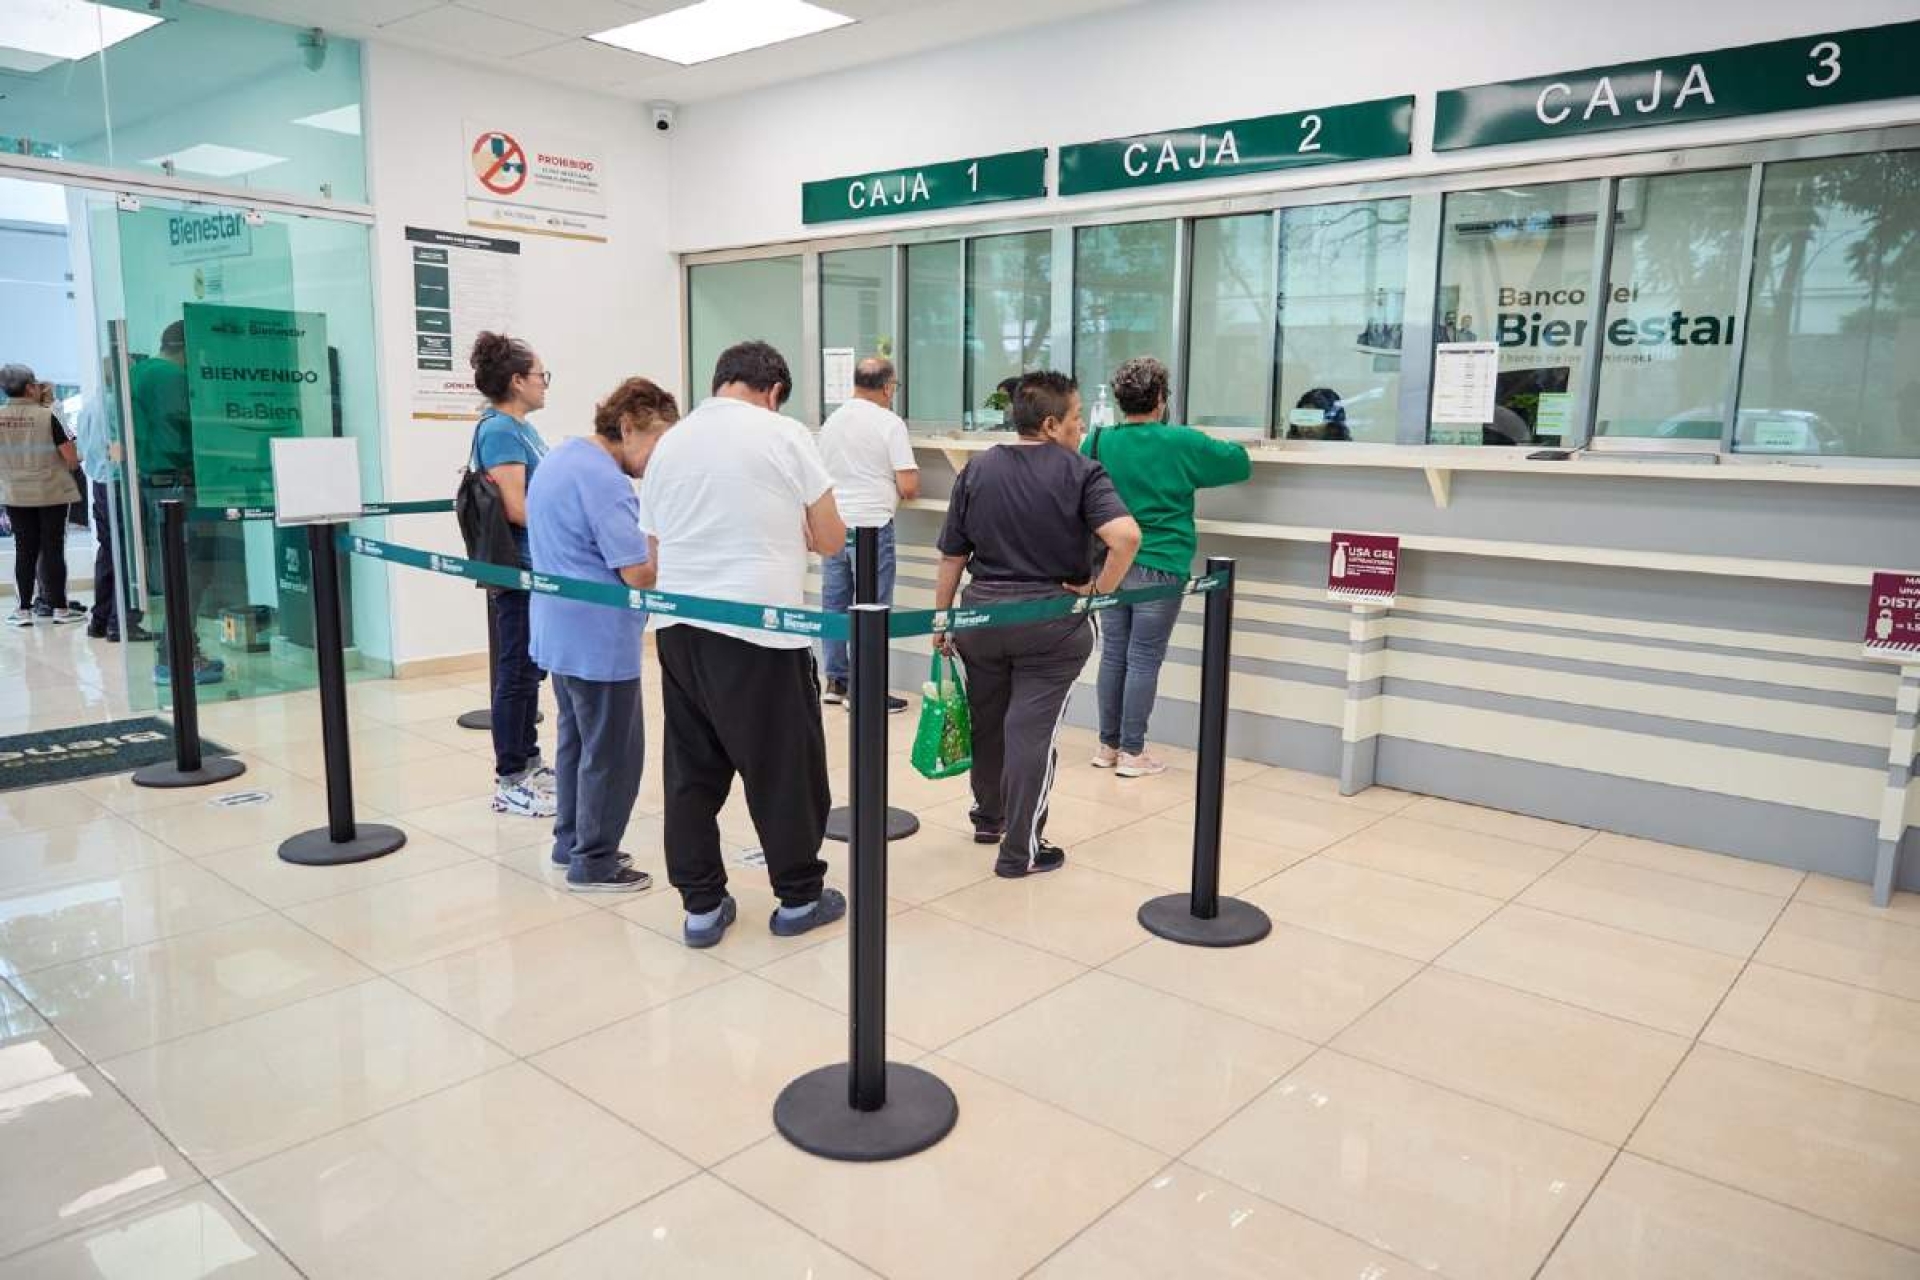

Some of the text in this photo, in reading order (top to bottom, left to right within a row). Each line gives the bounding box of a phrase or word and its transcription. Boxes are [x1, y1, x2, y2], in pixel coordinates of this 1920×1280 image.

[1535, 41, 1842, 125] CAJA 3
[1122, 114, 1323, 178] CAJA 2
[847, 162, 980, 209] CAJA 1
[169, 211, 242, 246] Bienestar
[1498, 281, 1640, 308] Banco el
[201, 366, 319, 384] BIENVENIDO
[225, 402, 301, 420] BaBien
[1348, 546, 1396, 560] USA GEL
